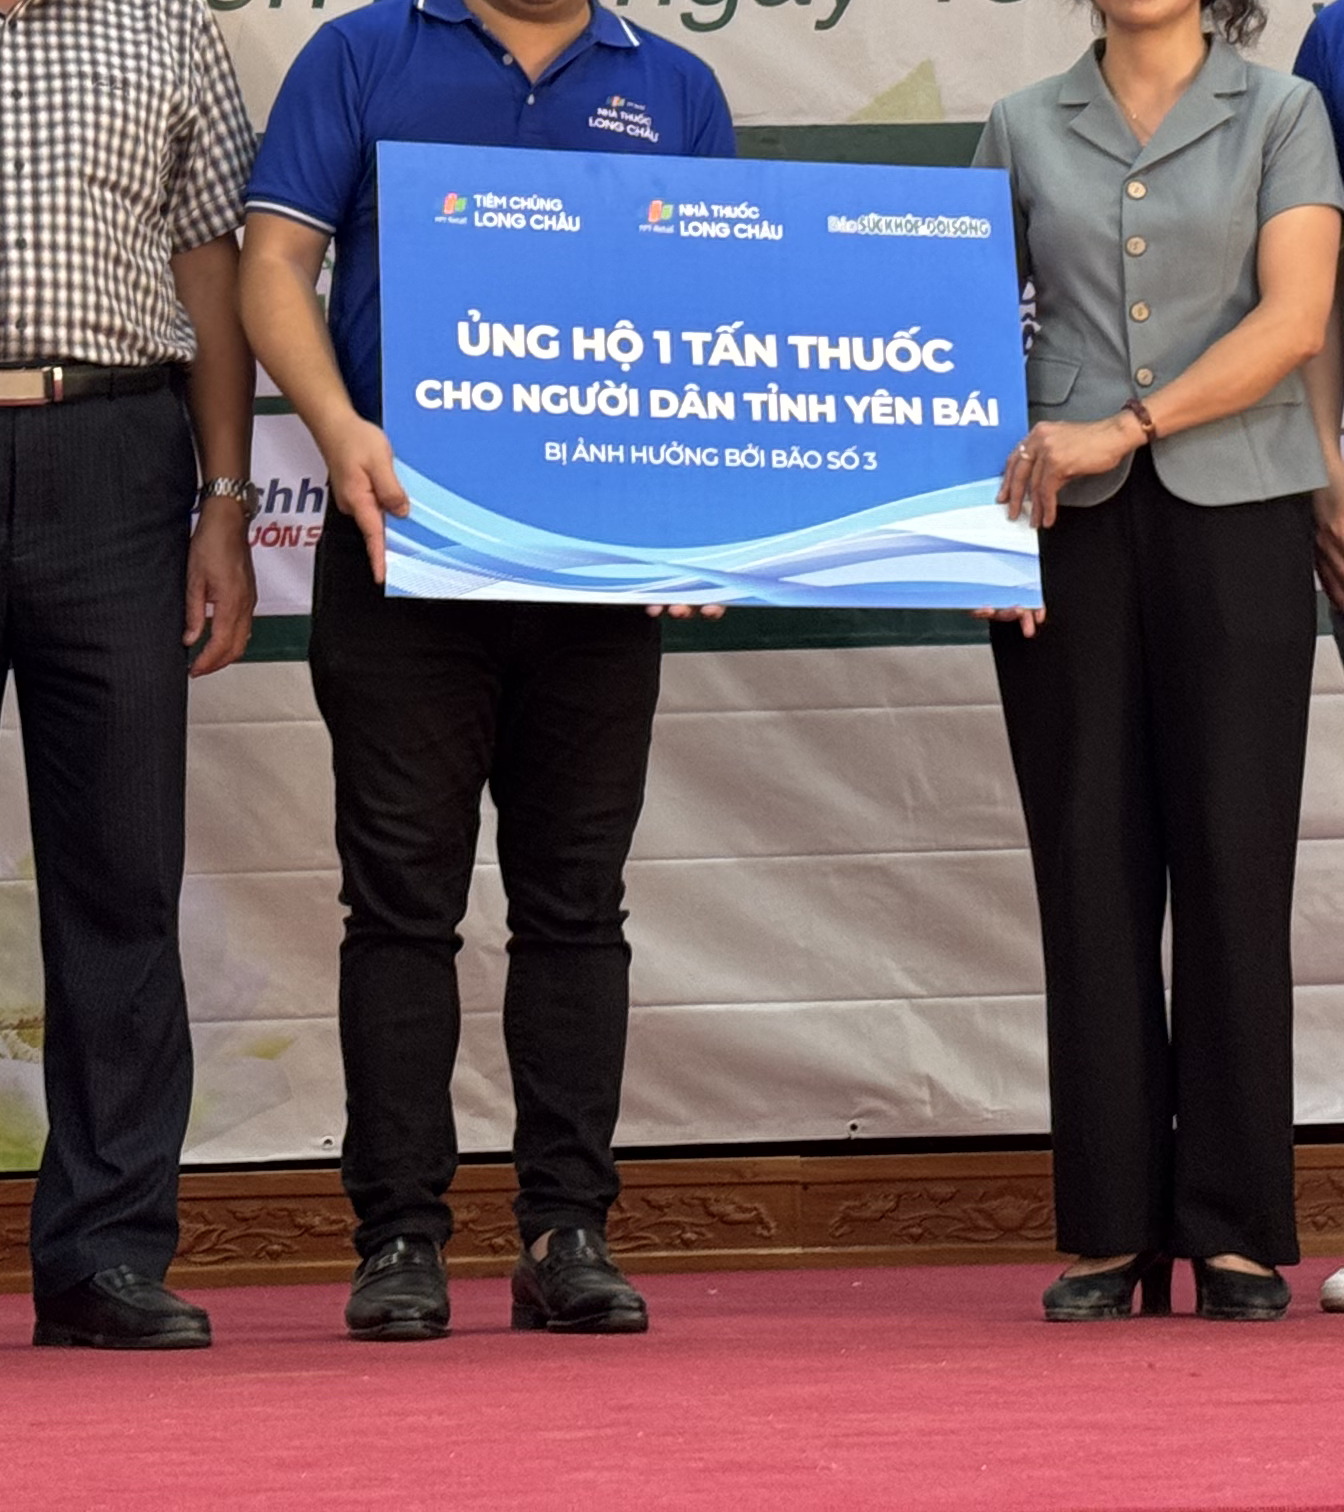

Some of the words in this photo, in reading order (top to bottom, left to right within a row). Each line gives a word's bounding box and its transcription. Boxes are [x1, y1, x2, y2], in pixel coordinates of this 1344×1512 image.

[588, 117, 625, 132] LONG
[678, 203, 707, 217] NHÀ
[711, 201, 760, 219] THUỐC
[473, 211, 527, 229] LONG
[529, 212, 581, 233] CHÂU
[679, 220, 730, 238] LONG
[733, 222, 783, 240] CHÂU
[457, 308, 561, 359] ỦNG
[572, 319, 644, 372] HỘ
[653, 329, 672, 365] 1
[682, 321, 778, 368] TẤN
[787, 326, 955, 373] THUỐC
[415, 379, 503, 411] CHO
[512, 379, 639, 417] NGƯỜI
[649, 383, 736, 420] DÂN
[743, 382, 836, 423] TỈNH
[844, 389, 923, 426] YÊN
[932, 391, 999, 427] BÁI
[544, 441, 568, 466] BỊ
[572, 437, 625, 464] ẢNH
[631, 440, 719, 467] HƯỞNG
[724, 443, 766, 469] BỞI
[771, 445, 823, 470] BÃO
[826, 446, 860, 471] SỐ
[862, 451, 878, 471] 3
